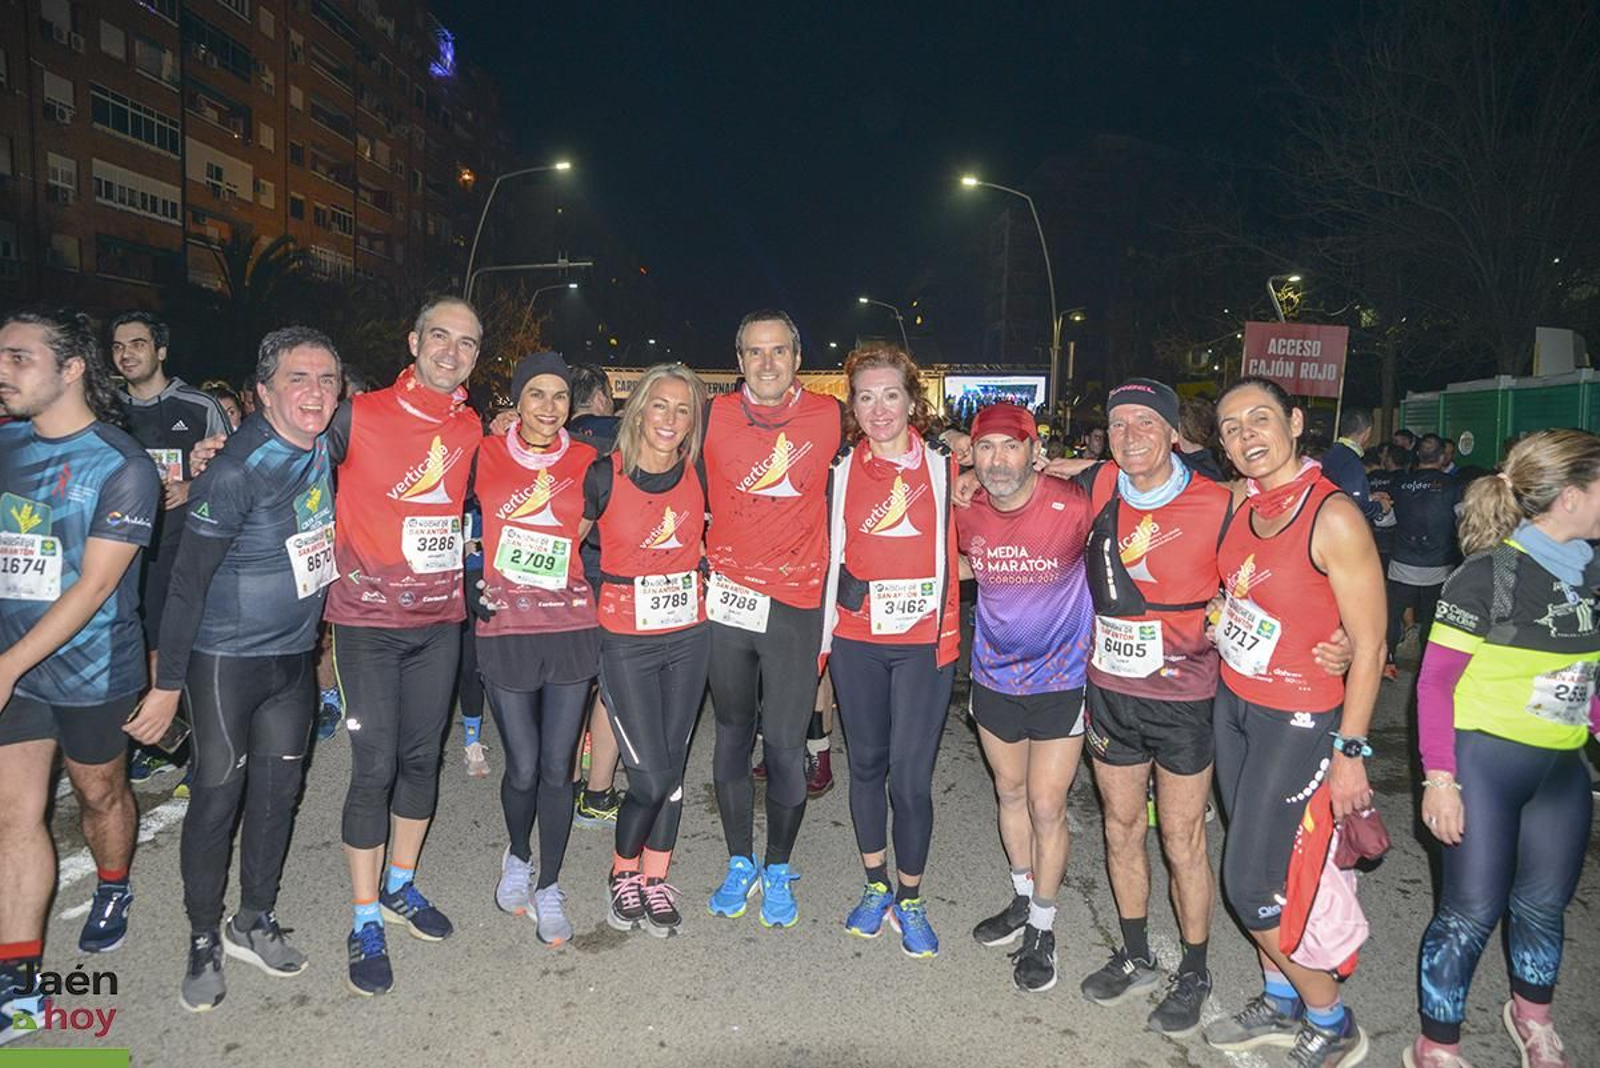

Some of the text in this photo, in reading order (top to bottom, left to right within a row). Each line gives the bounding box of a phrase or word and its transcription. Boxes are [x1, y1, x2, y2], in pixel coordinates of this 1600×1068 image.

[1267, 338, 1321, 357] ACCESO
[1248, 357, 1337, 380] CAJÓN ROJO
[416, 536, 455, 551] 3286
[987, 546, 1028, 558] MEDIA
[1, 557, 47, 575] 1674
[511, 548, 556, 570] 2709
[971, 557, 984, 571] 36
[987, 556, 1058, 572] MARATÓN
[650, 592, 688, 610] 3789
[720, 591, 758, 611] 3788
[884, 599, 928, 615] 3462
[1224, 620, 1260, 651] 3717
[1104, 637, 1147, 658] 6405
